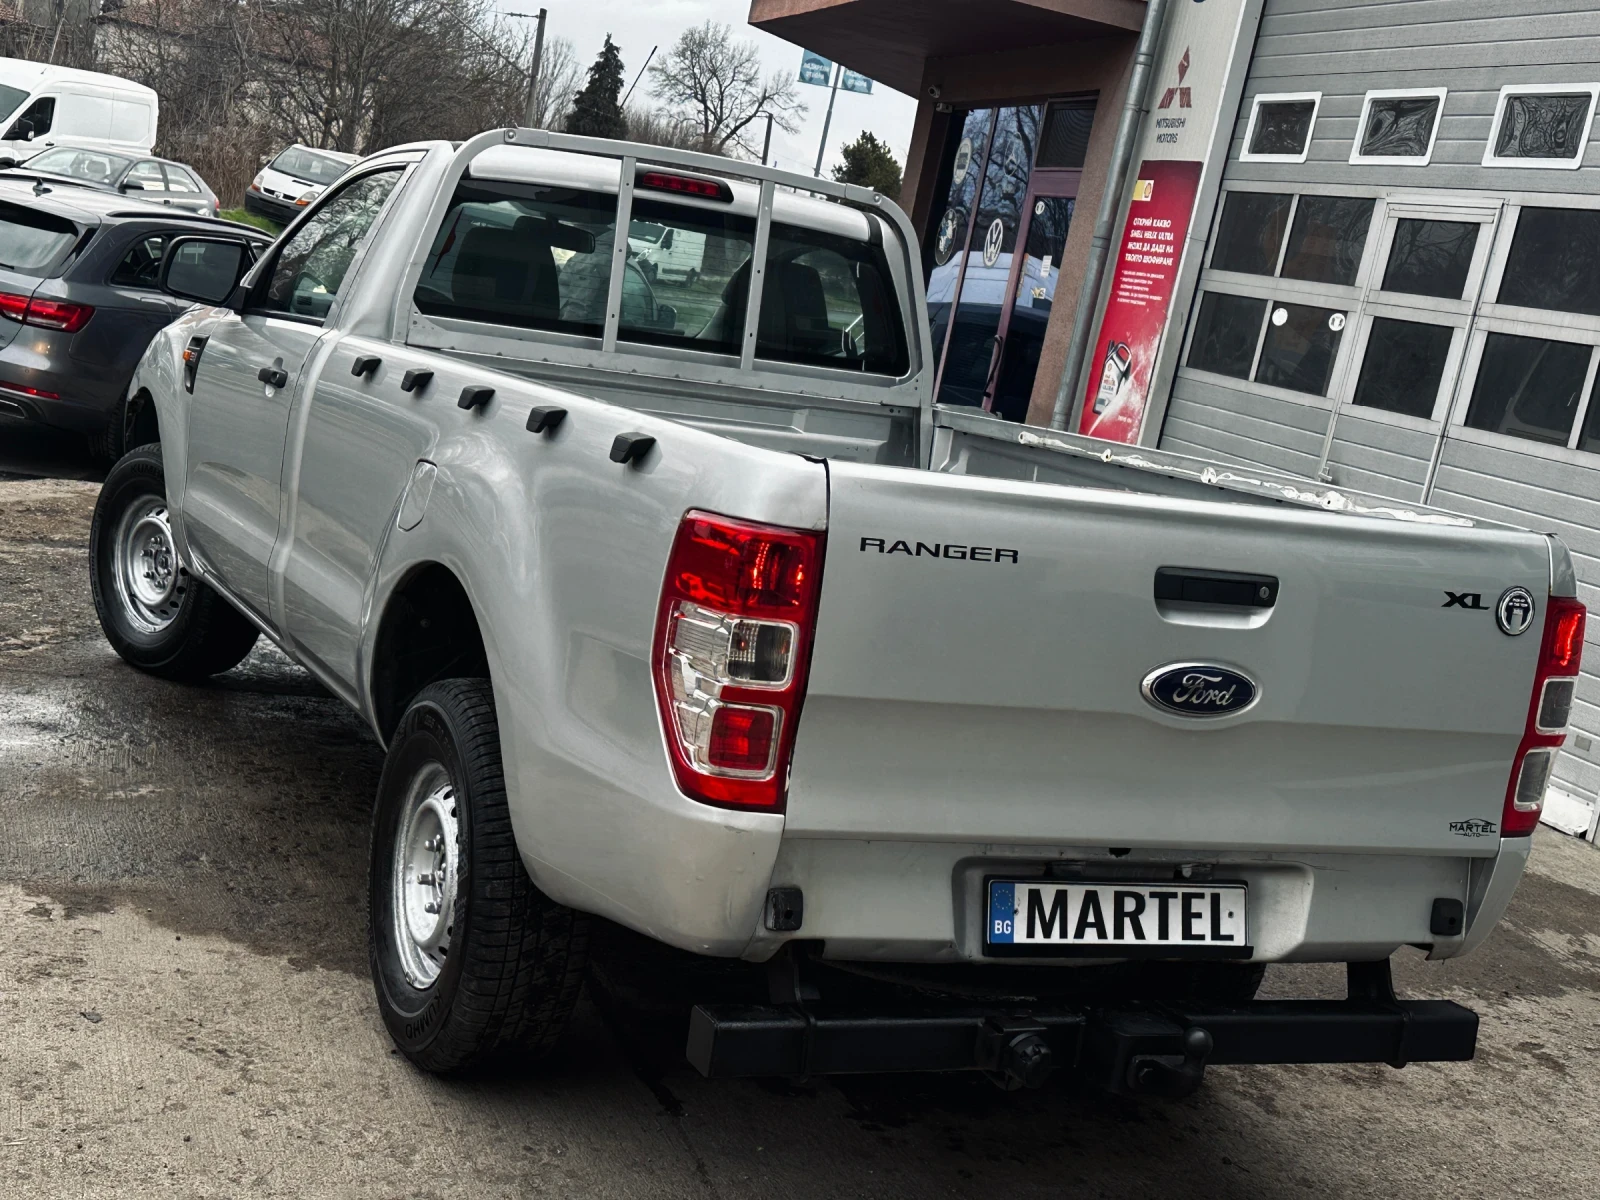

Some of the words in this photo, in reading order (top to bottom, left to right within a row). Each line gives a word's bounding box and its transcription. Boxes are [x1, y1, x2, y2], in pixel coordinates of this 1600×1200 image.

[860, 537, 1018, 564] RANGER
[1441, 590, 1490, 610] XL
[1172, 673, 1237, 705] Ford
[1449, 822, 1496, 833] MARTEL
[994, 919, 1012, 934] BG
[1026, 889, 1234, 941] MARTEL
[405, 988, 443, 1039] KUMHO
